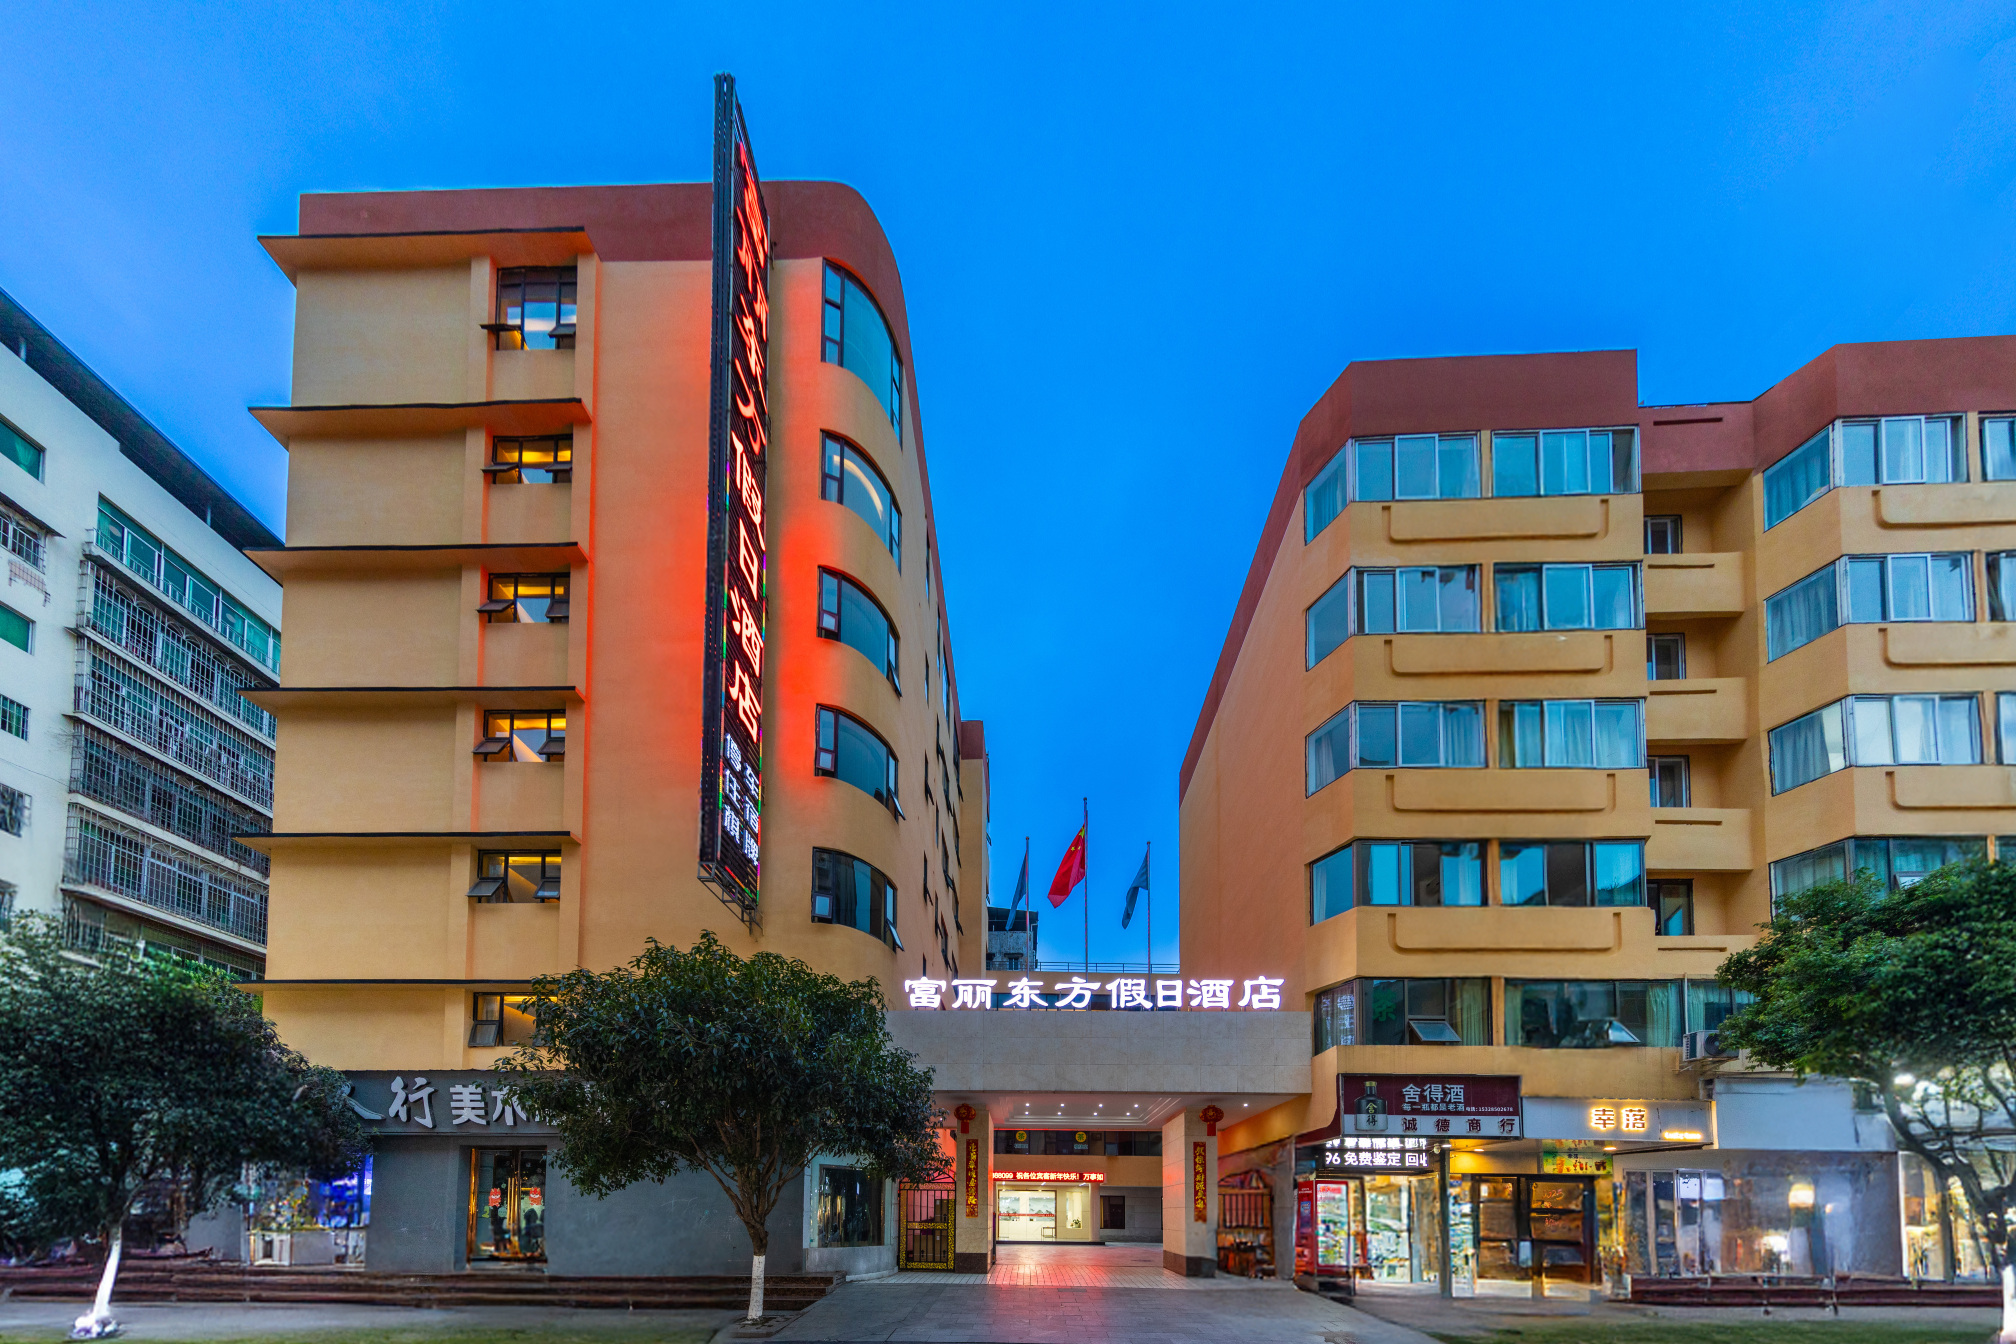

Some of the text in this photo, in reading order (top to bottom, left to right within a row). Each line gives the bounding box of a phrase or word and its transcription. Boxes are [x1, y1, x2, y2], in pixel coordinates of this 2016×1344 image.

[730, 141, 768, 742] 富丽东方假日酒店
[904, 975, 1285, 1010] 富丽东方假日酒店
[1401, 1083, 1465, 1103] 舍得酒
[1402, 1103, 1465, 1112] 每一瓶都是老酒
[1401, 1117, 1516, 1134] 诚德商行
[1344, 1151, 1402, 1166] 免费鉴定
